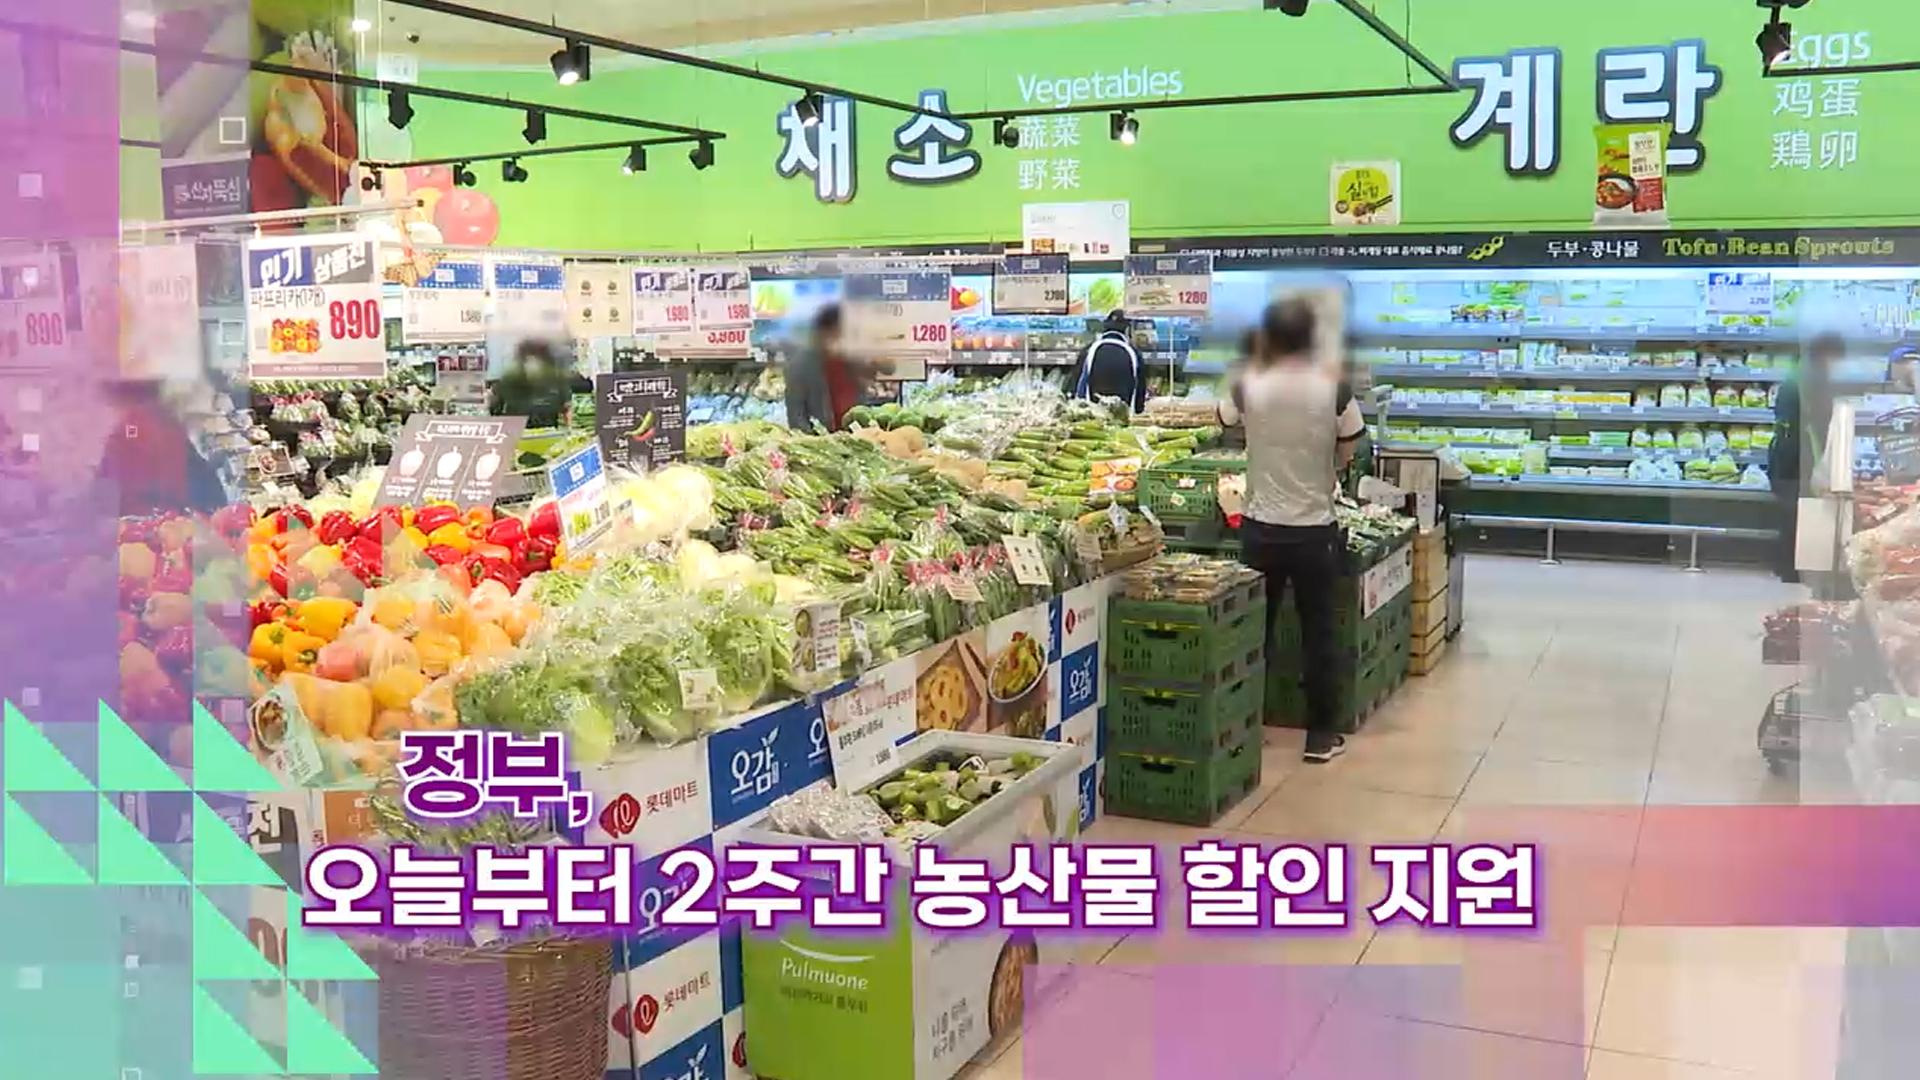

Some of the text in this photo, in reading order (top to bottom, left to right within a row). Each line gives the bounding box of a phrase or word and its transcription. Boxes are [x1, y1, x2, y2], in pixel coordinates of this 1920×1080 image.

[1017, 65, 1184, 108] Vegetables
[1018, 158, 1081, 190] 野菜
[1794, 236, 1895, 260] Sprouts
[260, 247, 302, 288] 인기
[26, 312, 63, 345] 890
[329, 299, 380, 340] 890
[912, 325, 946, 343] 1,280
[730, 743, 776, 796] 오감
[645, 781, 699, 814] 롯데마트
[781, 956, 870, 991] Pulmuone
